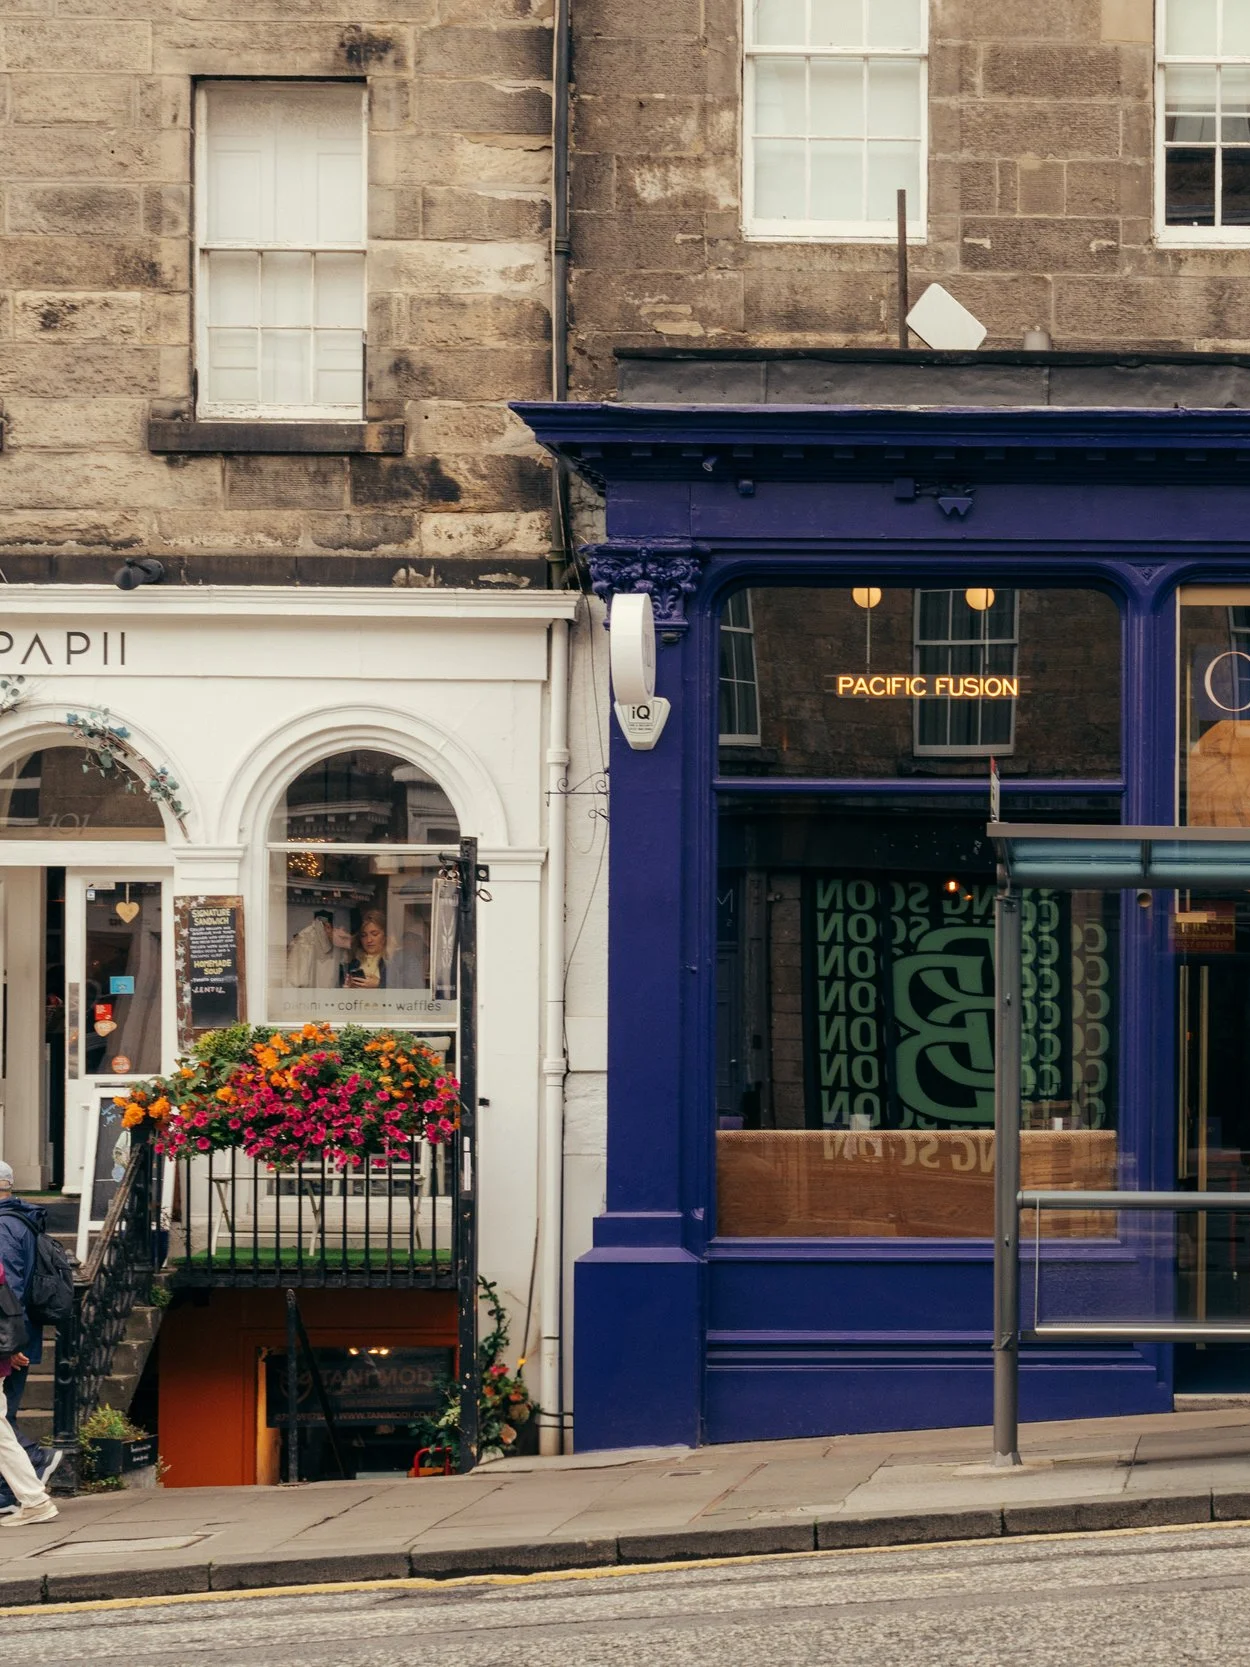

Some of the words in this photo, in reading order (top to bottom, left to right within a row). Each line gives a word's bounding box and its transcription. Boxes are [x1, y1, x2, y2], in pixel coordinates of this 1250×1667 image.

[837, 676, 928, 698] PACIFIC
[934, 676, 1019, 698] FUSION
[631, 704, 651, 720] iQ
[49, 812, 91, 836] 101
[191, 908, 231, 918] SIGNATURE
[193, 917, 230, 926] SANDWICH
[193, 959, 232, 968] HOMEMADE
[203, 967, 224, 976] SOUP
[337, 999, 379, 1012] coffee
[395, 999, 442, 1012] waffles
